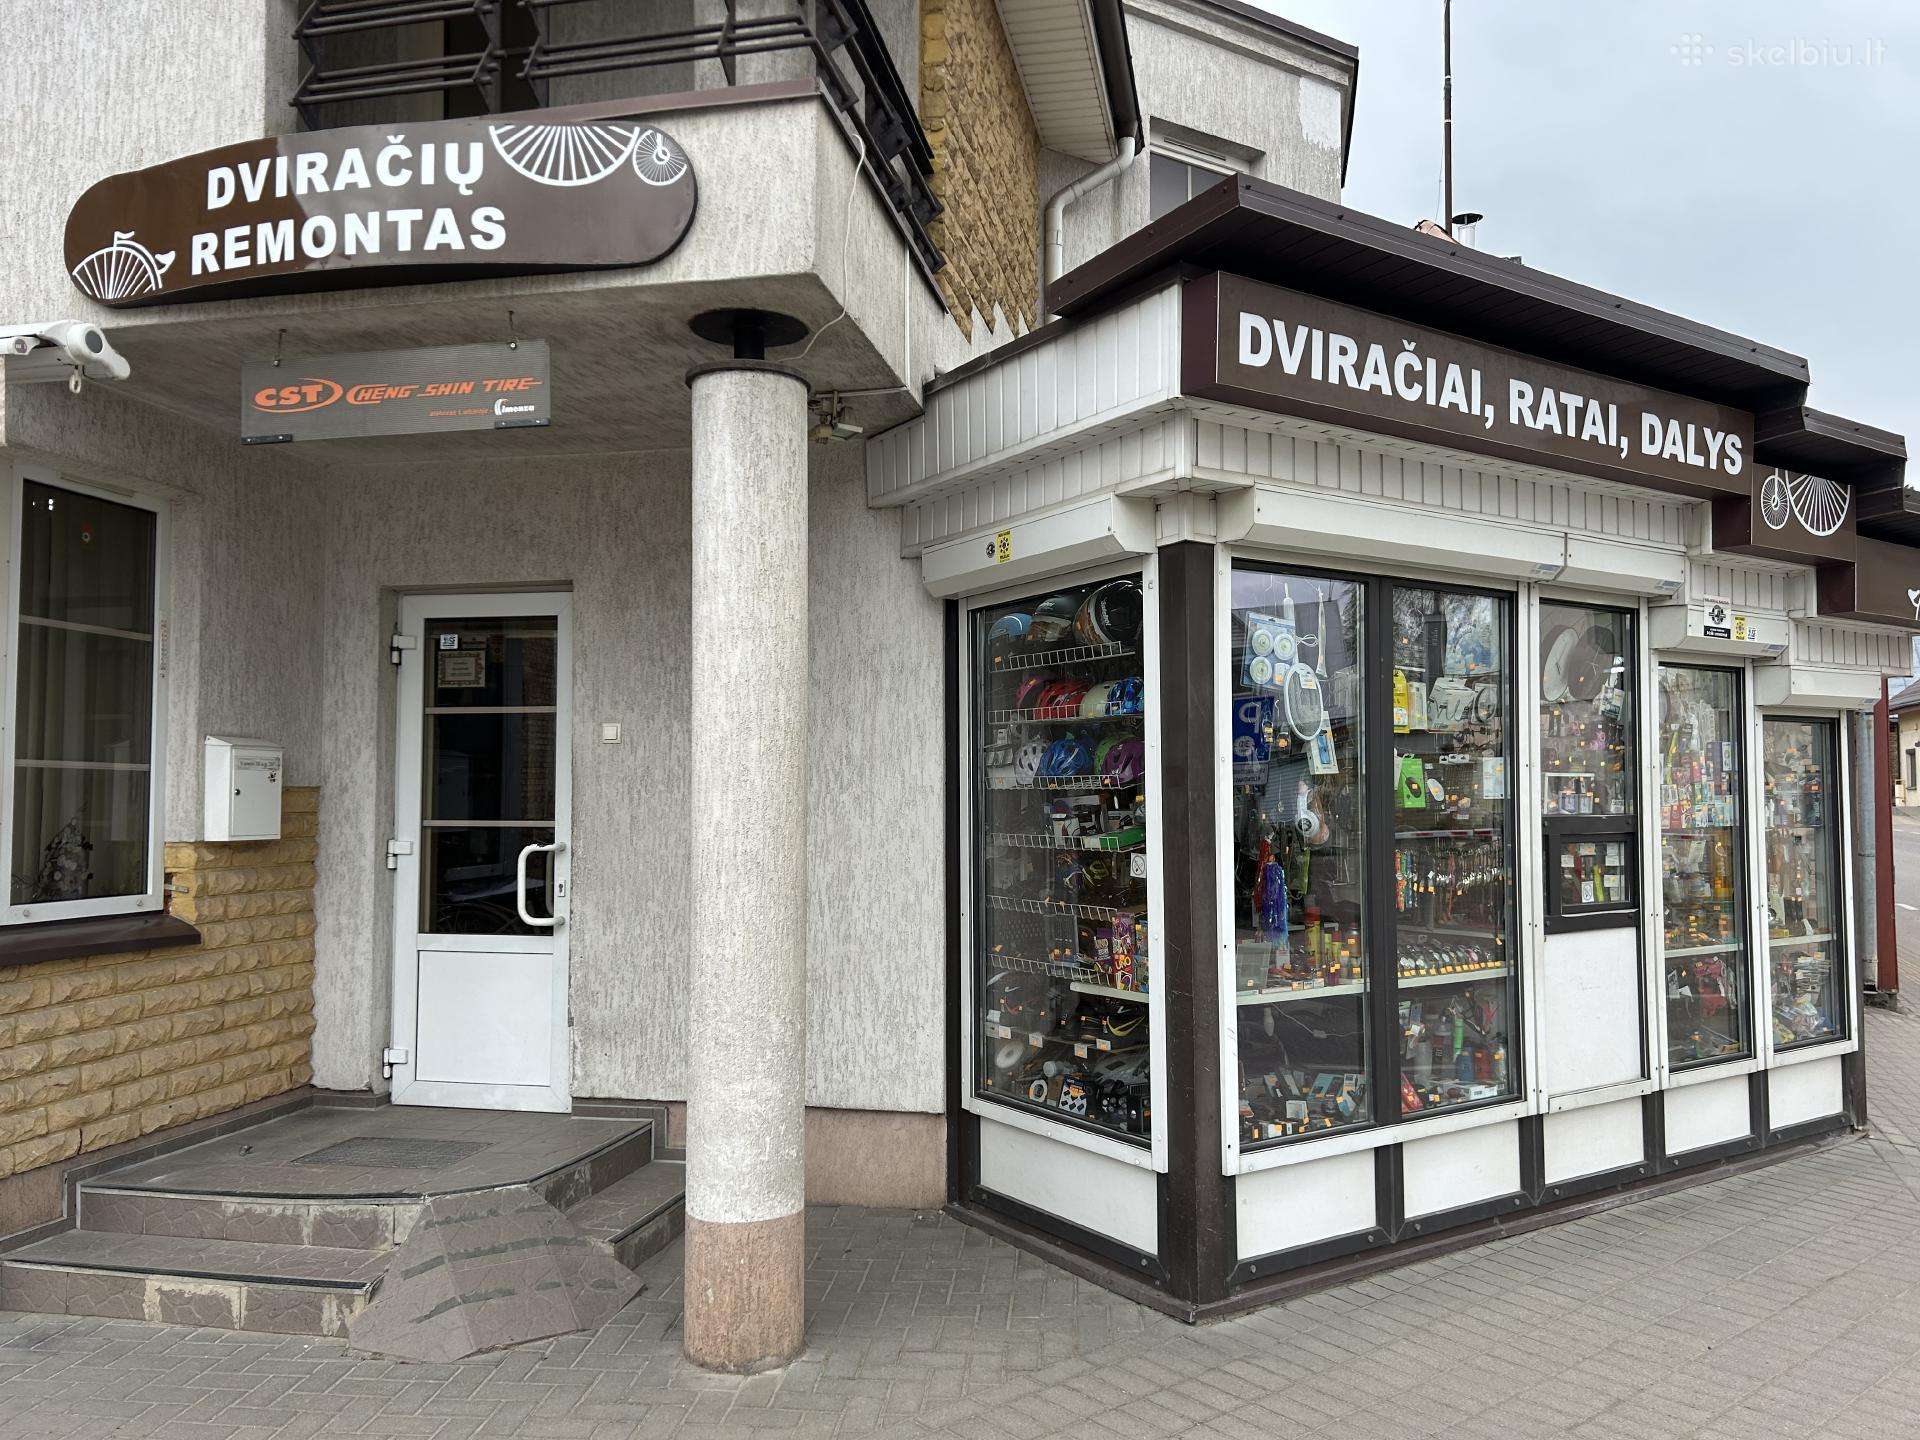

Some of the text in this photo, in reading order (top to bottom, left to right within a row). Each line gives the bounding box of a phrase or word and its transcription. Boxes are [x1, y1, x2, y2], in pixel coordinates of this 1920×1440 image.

[207, 134, 485, 210] DVIRAČIŲ
[191, 206, 507, 276] REMONTAS
[252, 376, 544, 409] CST CHENG SHIN TIRE
[1238, 311, 1743, 476] DVIRAČIAI, RATAI, DALYS
